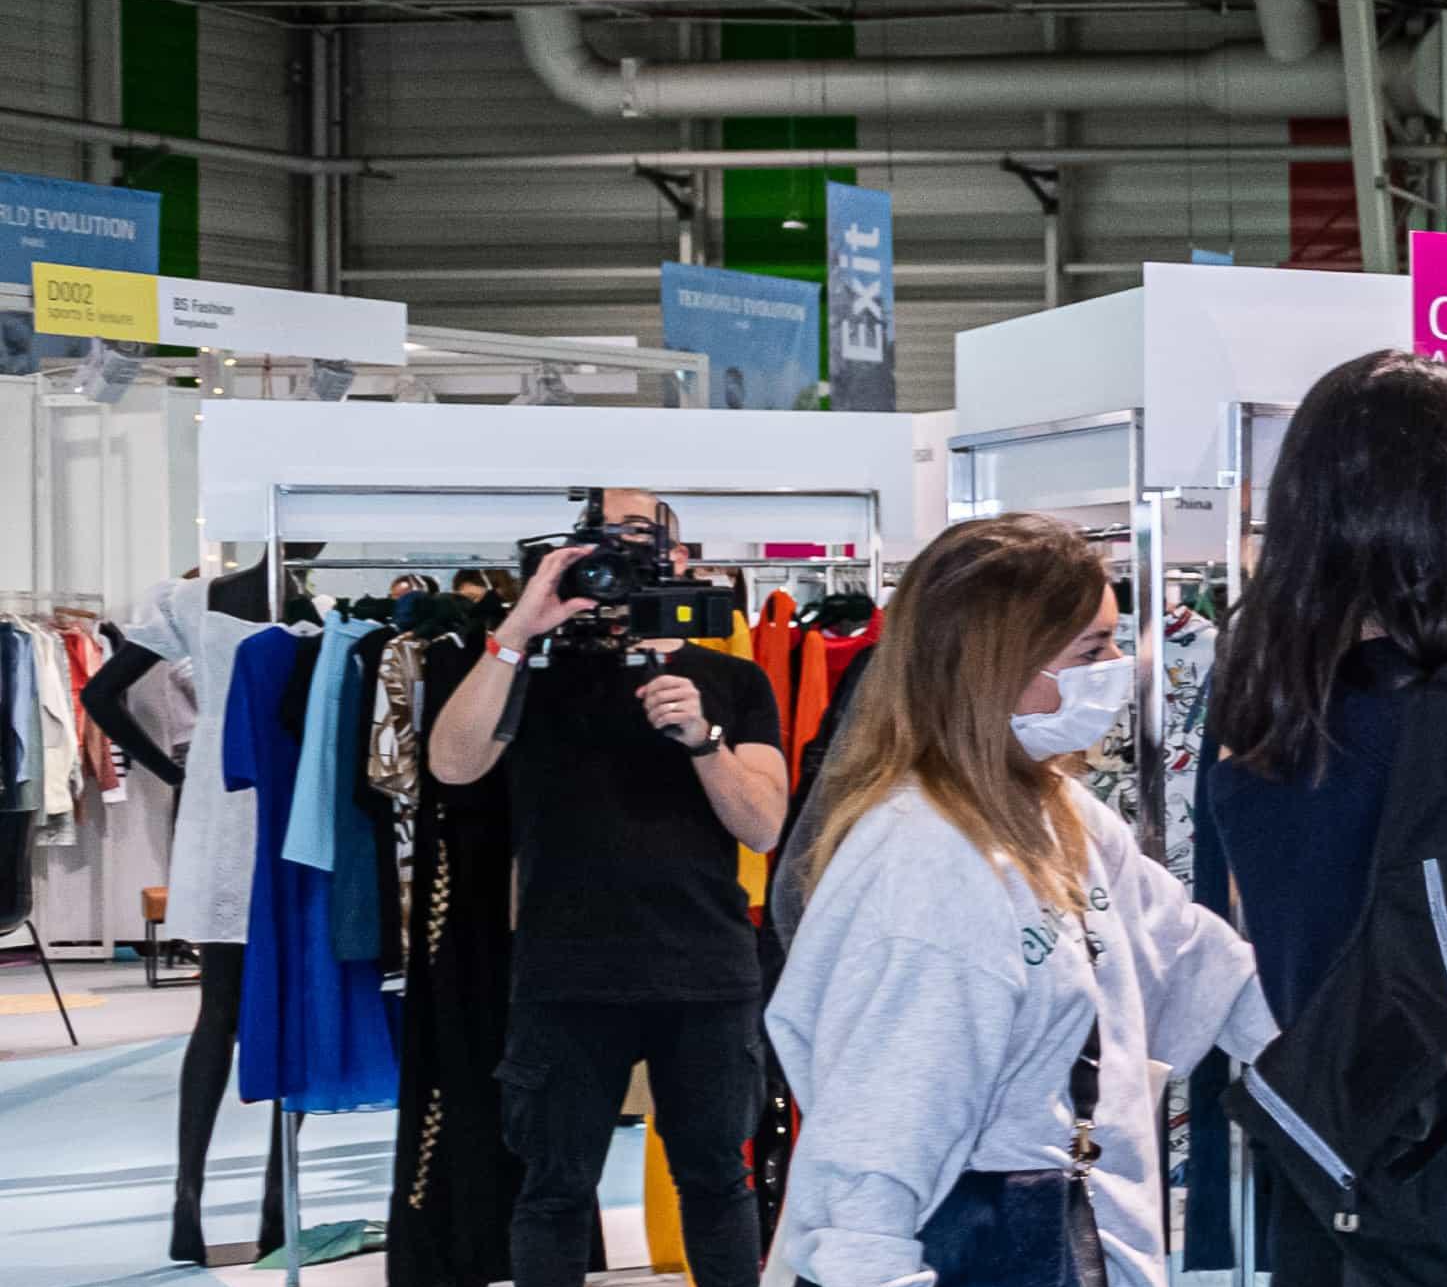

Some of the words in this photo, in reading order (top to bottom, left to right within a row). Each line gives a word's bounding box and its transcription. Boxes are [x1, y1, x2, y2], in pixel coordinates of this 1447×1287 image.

[34, 209, 136, 241] EVOLUTION
[47, 279, 93, 306] D002
[838, 222, 884, 363] Exit
[192, 297, 235, 316] Fashion
[1175, 498, 1213, 511] hina
